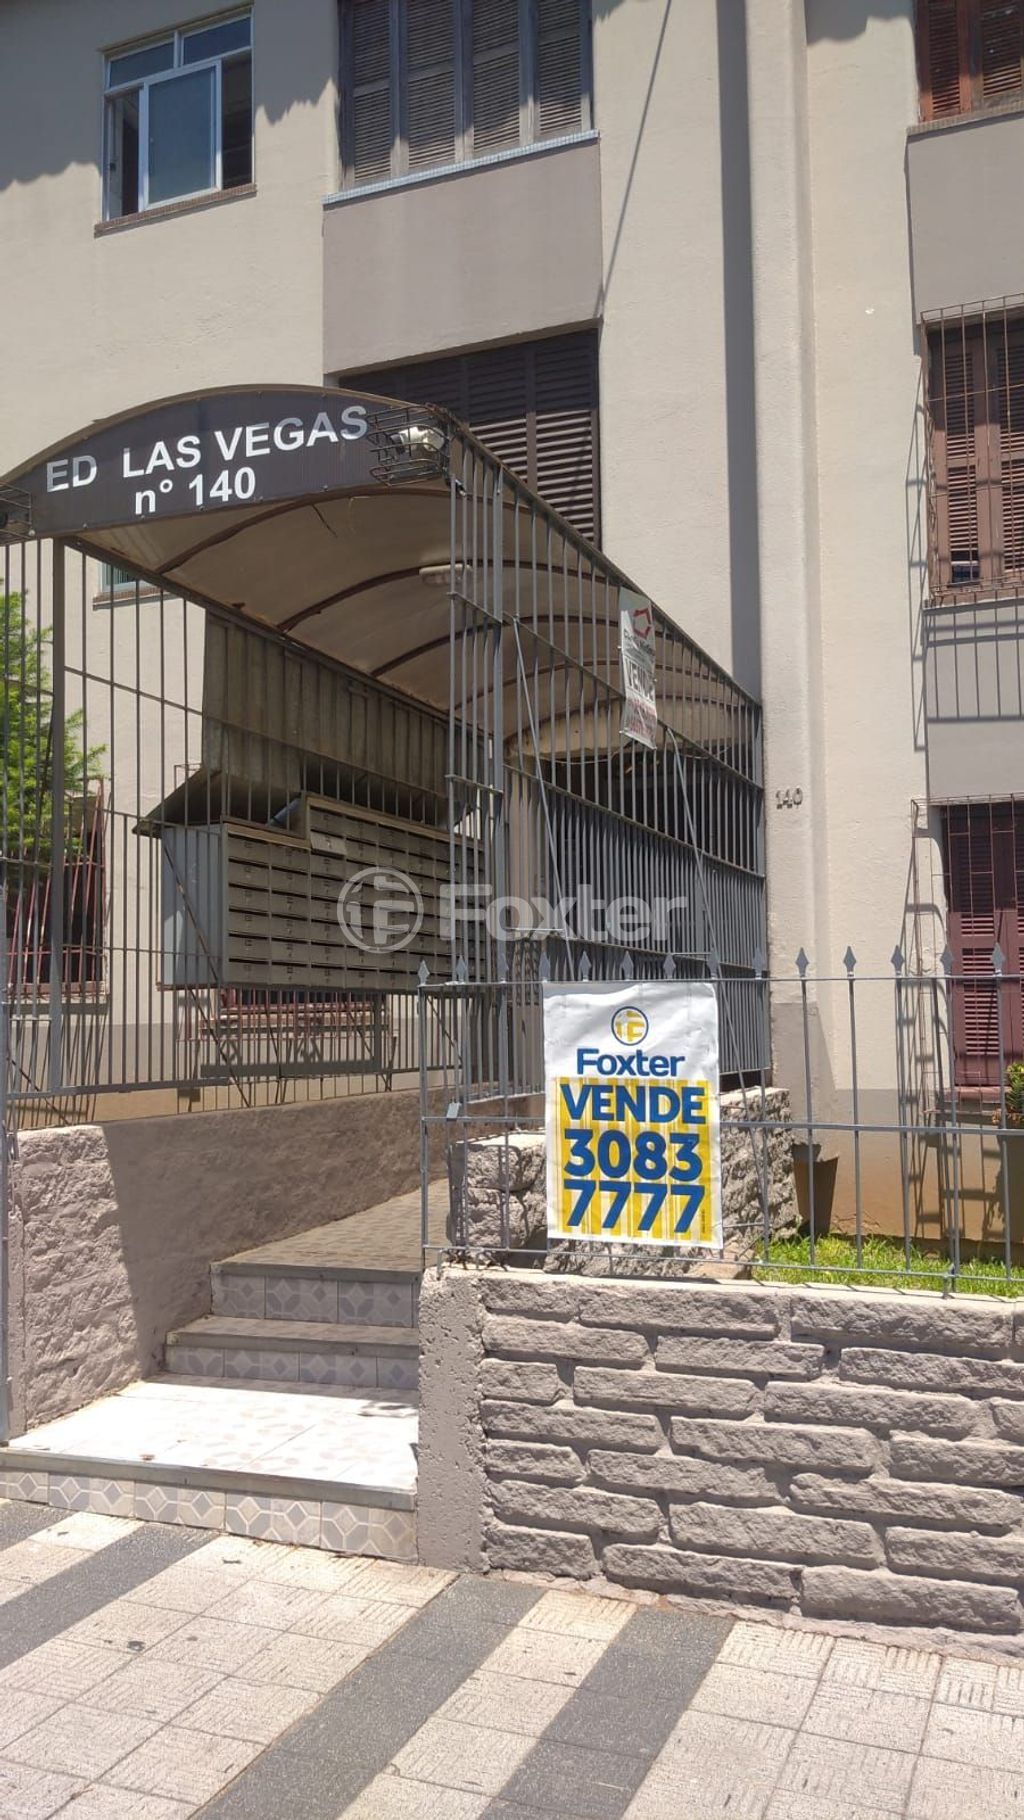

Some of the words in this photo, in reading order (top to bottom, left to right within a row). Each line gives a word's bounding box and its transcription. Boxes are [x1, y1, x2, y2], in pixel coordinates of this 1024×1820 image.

[46, 455, 98, 493] ED
[122, 435, 201, 478] LAS
[214, 405, 369, 461] VEGAS
[188, 466, 257, 506] 140
[775, 787, 804, 810] 140
[576, 1048, 686, 1077] Foxter
[560, 1083, 707, 1125] VENDE
[563, 1128, 703, 1182] 3083
[563, 1178, 706, 1234] 7777
